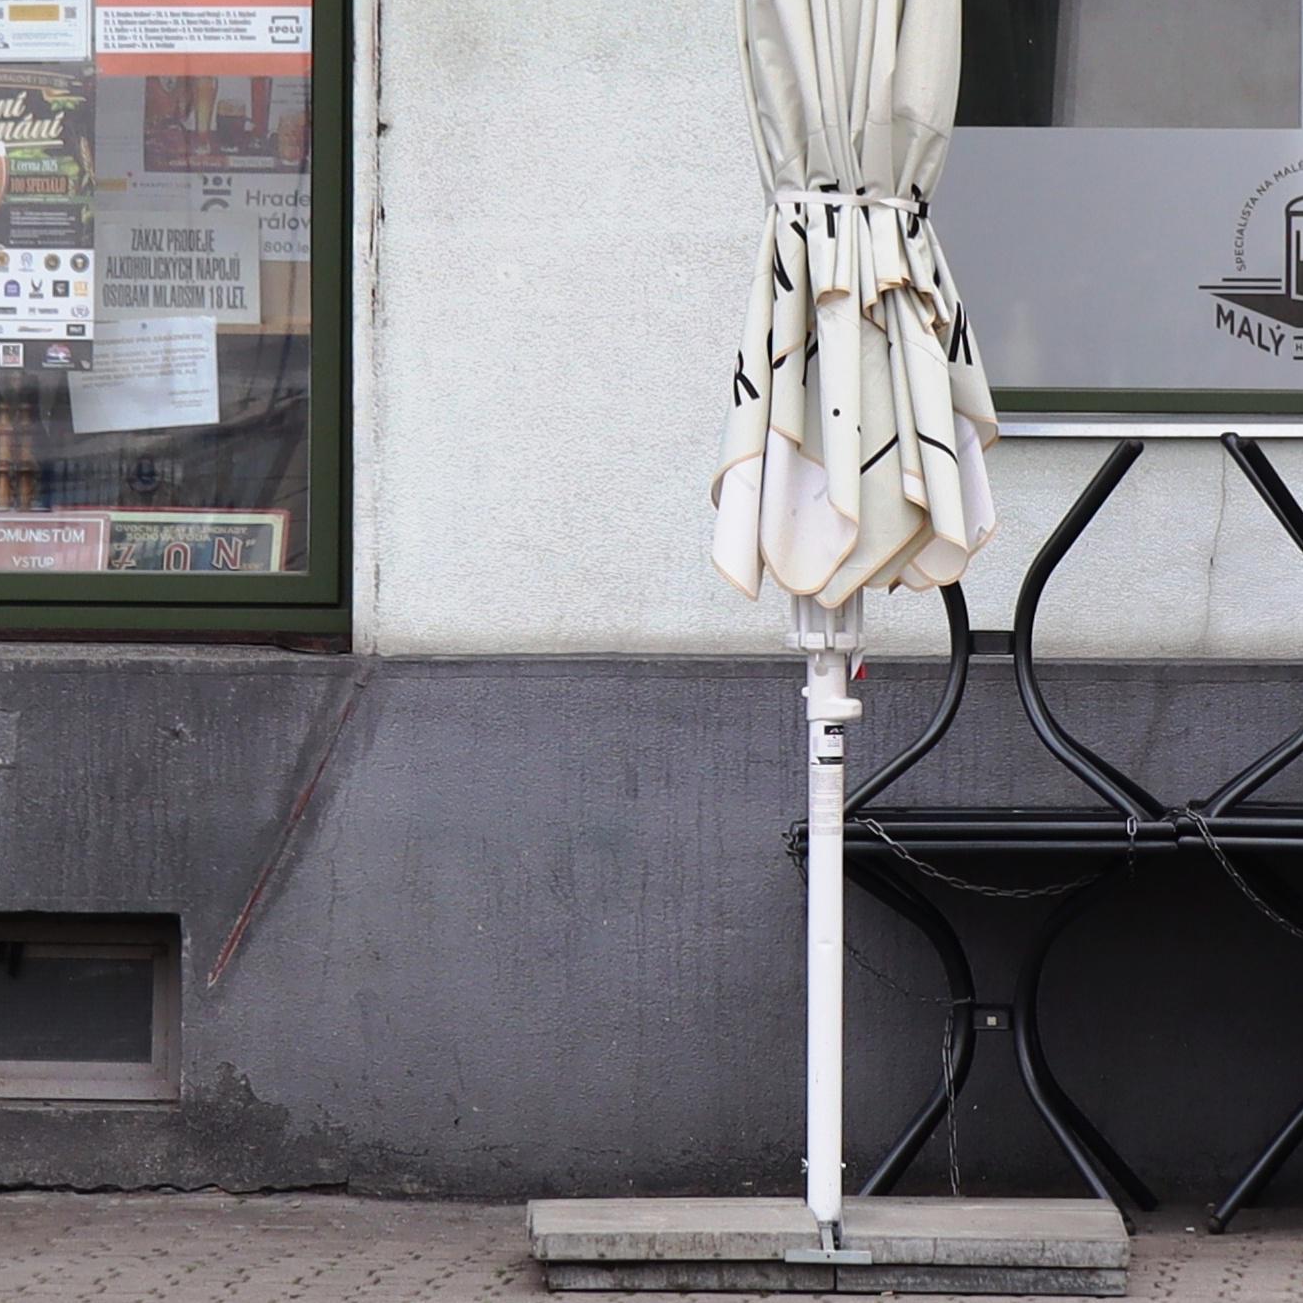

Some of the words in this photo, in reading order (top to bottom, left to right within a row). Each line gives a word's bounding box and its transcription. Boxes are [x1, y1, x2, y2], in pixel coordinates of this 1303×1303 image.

[246, 188, 310, 207] Hrade
[259, 212, 310, 231] rálov
[1234, 197, 1259, 273] SPECIALISTA
[1256, 179, 1273, 196] NA
[131, 223, 164, 252] ZÁKAZ
[167, 228, 215, 253] PRODEJE
[210, 286, 223, 309] 18
[1215, 302, 1286, 357] MALÝ
[11, 555, 54, 568] VSTUP
